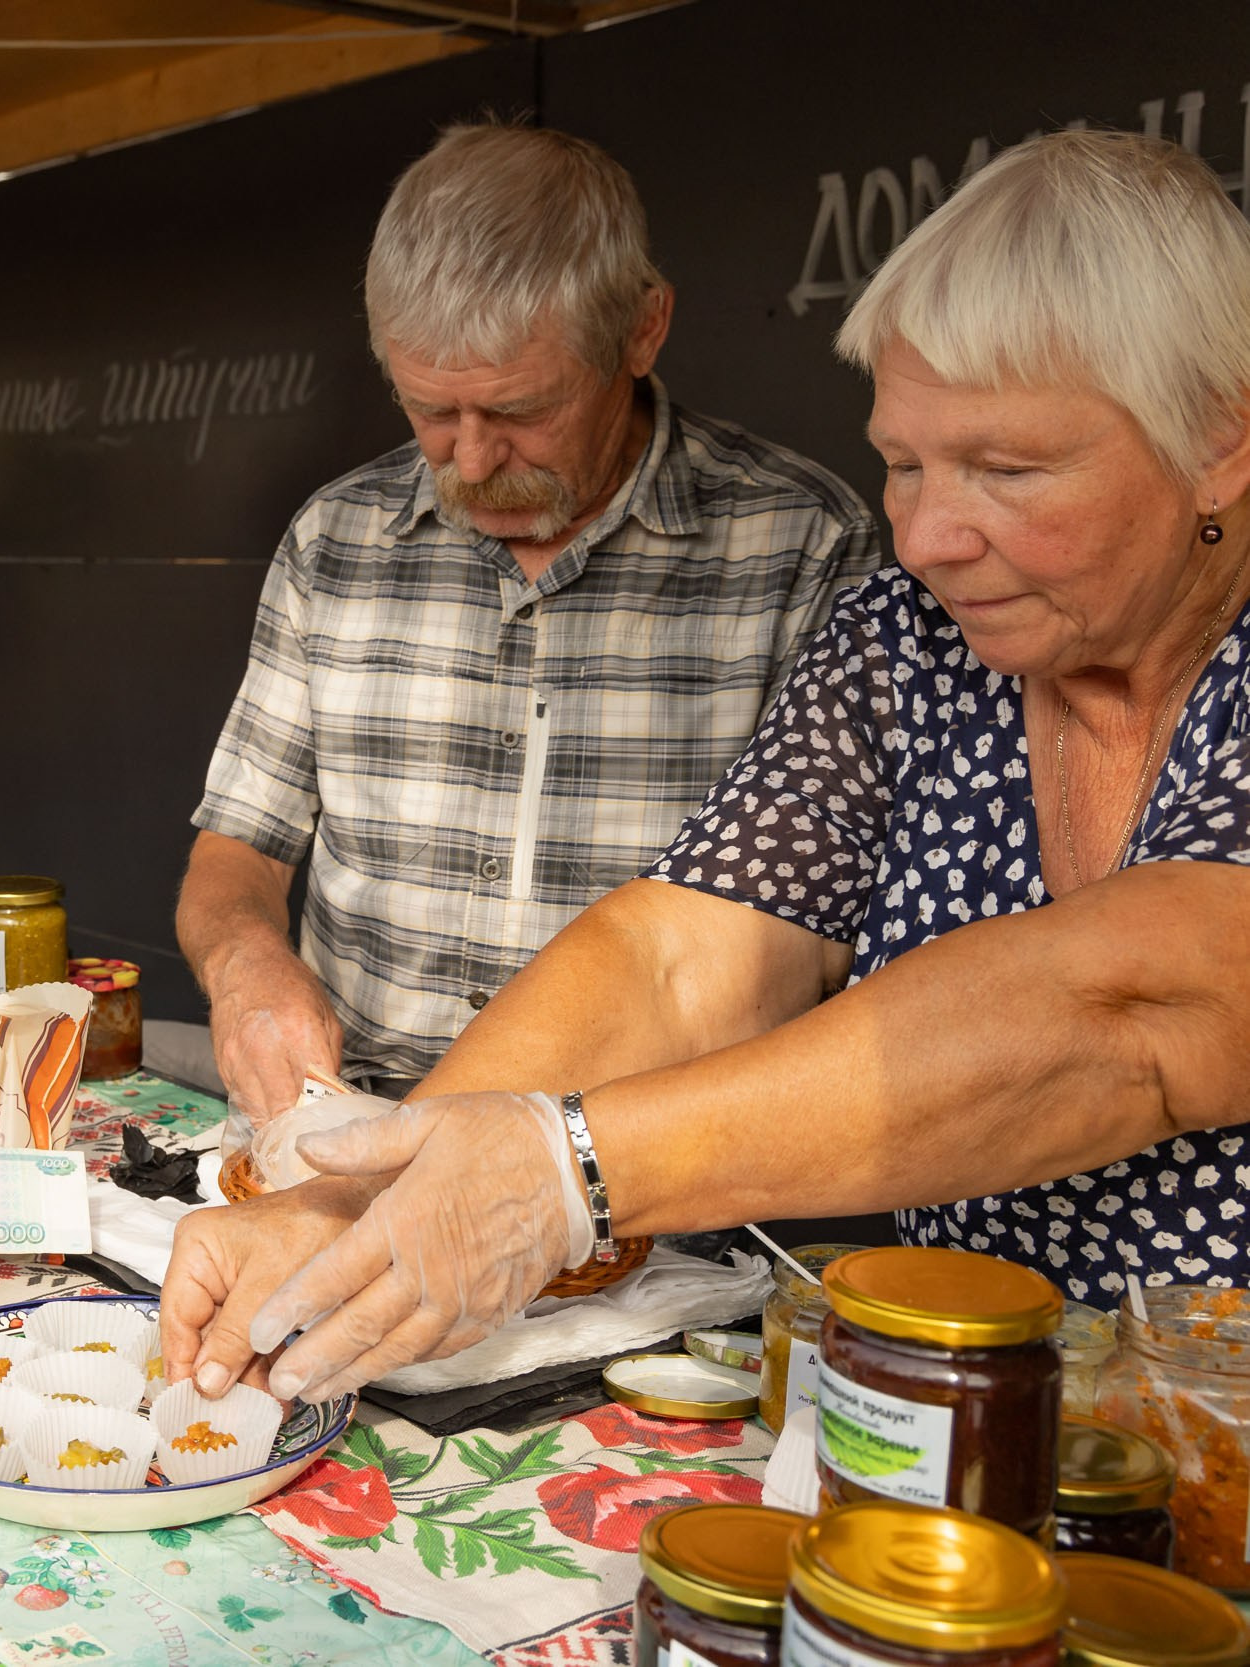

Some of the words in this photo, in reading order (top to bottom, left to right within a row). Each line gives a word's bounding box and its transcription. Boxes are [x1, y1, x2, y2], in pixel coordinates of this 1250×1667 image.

[97, 346, 318, 464] штучки
[41, 1158, 70, 1169] 1000
[863, 1400, 915, 1425] продукт
[144, 1600, 171, 1627] LA
